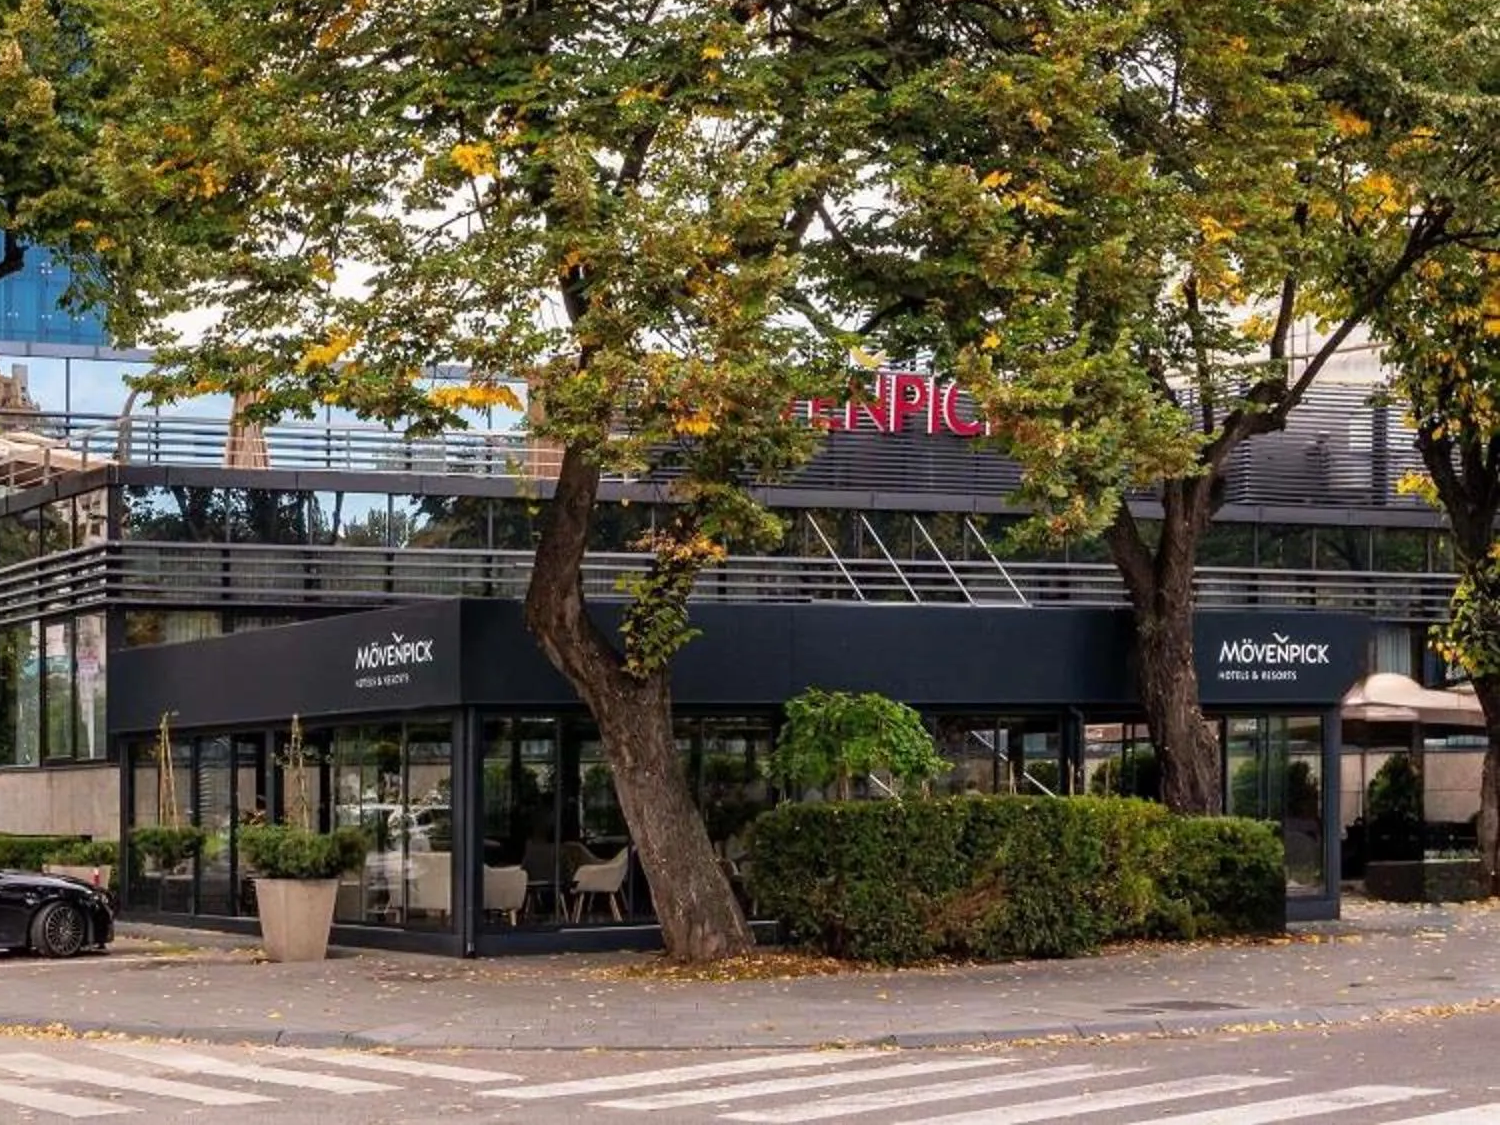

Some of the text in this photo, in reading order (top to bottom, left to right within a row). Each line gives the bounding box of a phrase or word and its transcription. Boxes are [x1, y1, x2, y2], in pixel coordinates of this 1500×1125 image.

[779, 373, 992, 436] ENPIC
[355, 640, 433, 670] MÖVENPICK
[1219, 638, 1329, 664] MÖVENPICK
